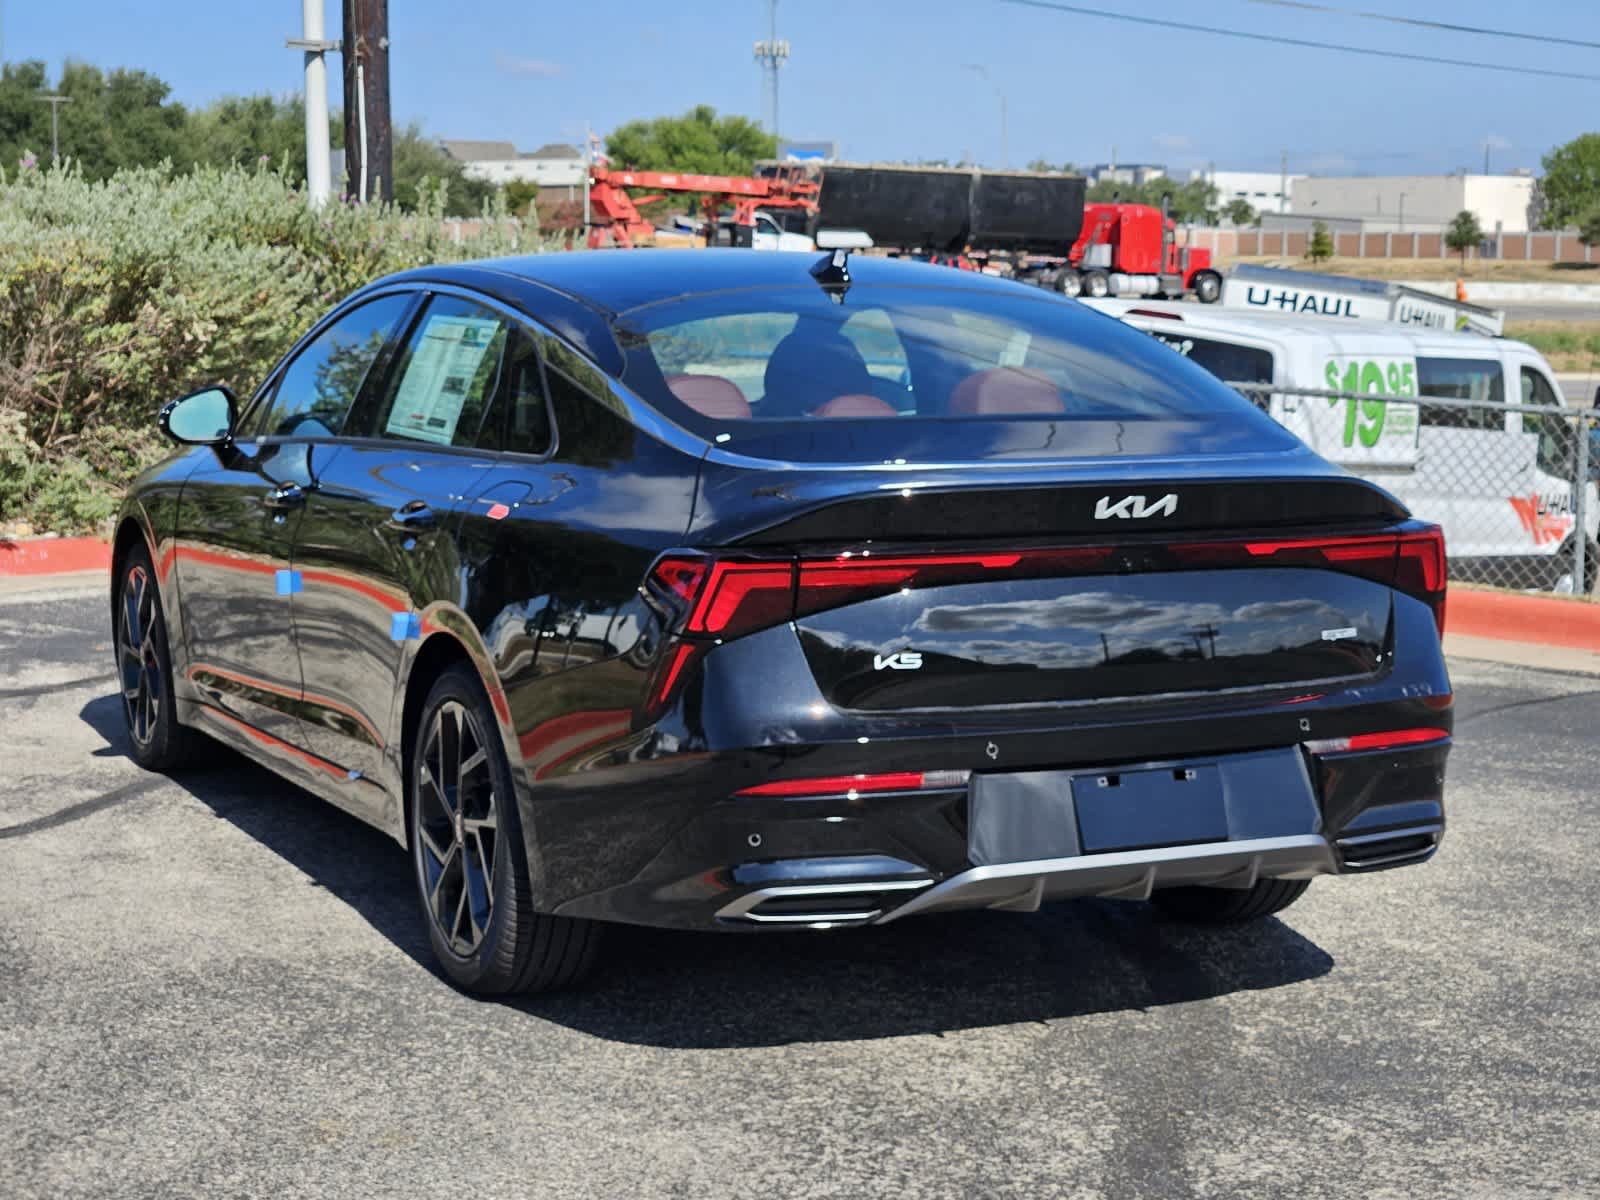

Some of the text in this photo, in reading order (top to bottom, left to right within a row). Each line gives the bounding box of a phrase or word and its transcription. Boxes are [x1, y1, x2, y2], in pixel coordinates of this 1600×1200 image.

[1247, 286, 1360, 319] U-HAUL
[1094, 493, 1178, 519] KIA
[873, 653, 923, 670] K5
